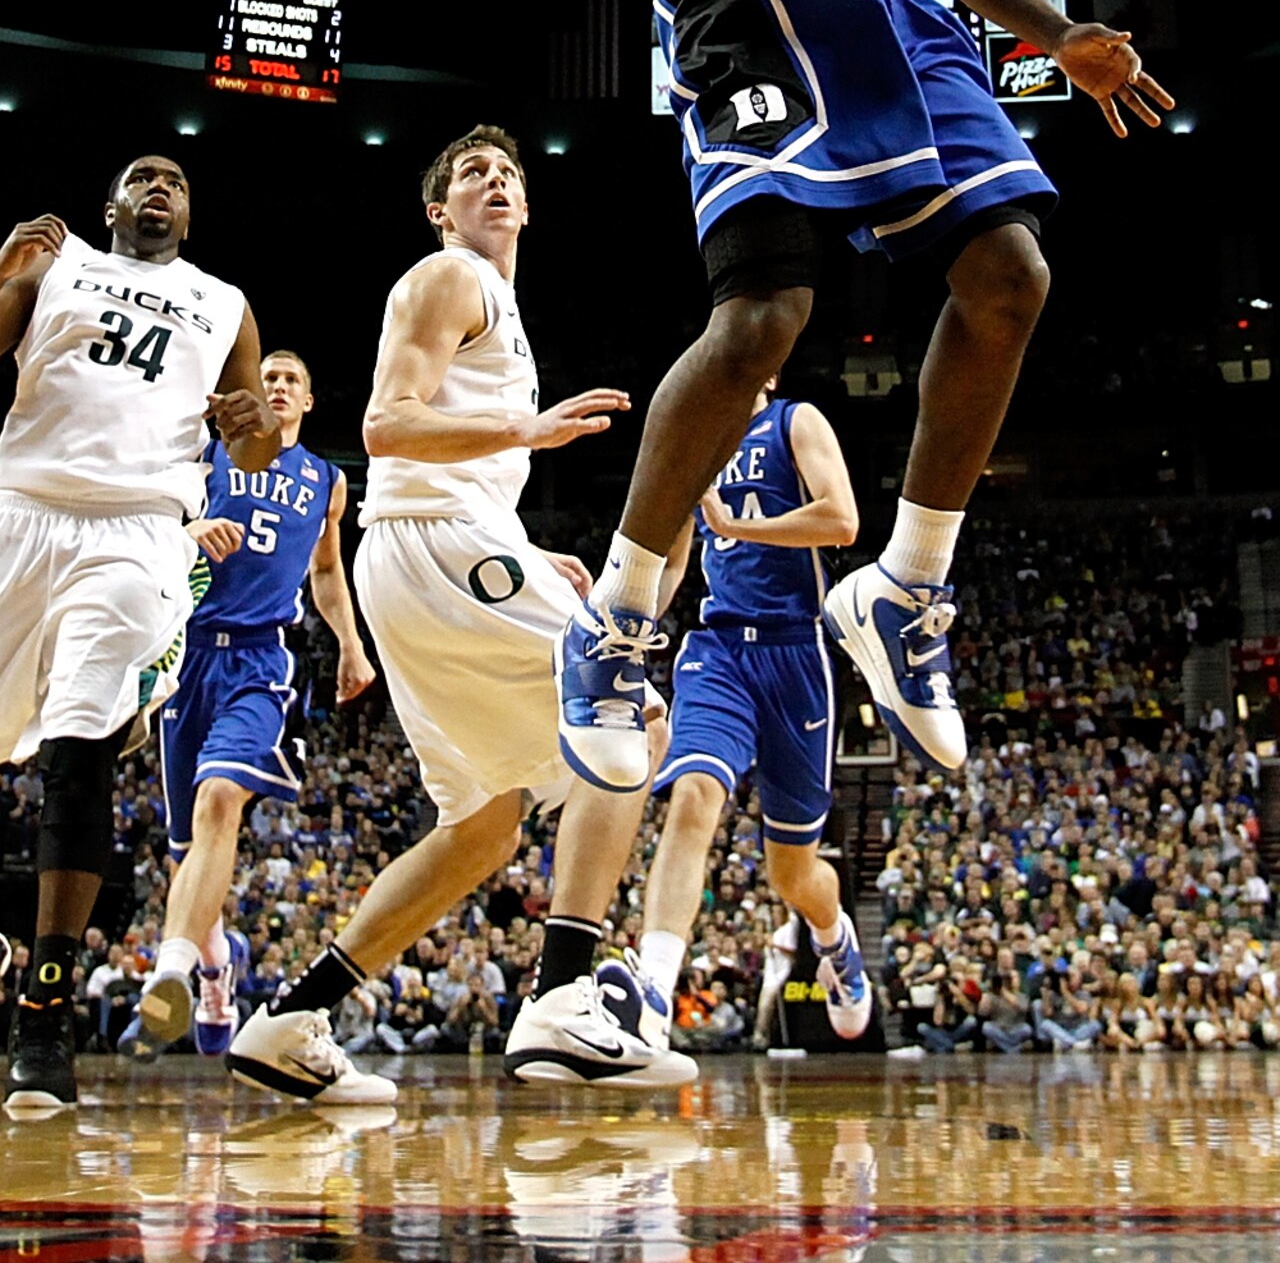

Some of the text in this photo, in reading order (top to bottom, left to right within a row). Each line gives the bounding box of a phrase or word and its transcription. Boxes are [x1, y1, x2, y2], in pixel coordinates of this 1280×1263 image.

[237, 0, 284, 18] BLOCKED
[285, 5, 318, 24] SHOTS
[241, 18, 313, 41] REBOUNDS
[245, 38, 307, 59] STEALS
[249, 59, 300, 80] TOTAL
[999, 56, 1057, 88] Pizza
[1010, 69, 1054, 94] Hut
[214, 76, 248, 92] xfinity
[72, 278, 214, 335] DUCKS
[88, 309, 174, 384] 34
[228, 467, 315, 517] DUKE
[245, 510, 282, 555] 5
